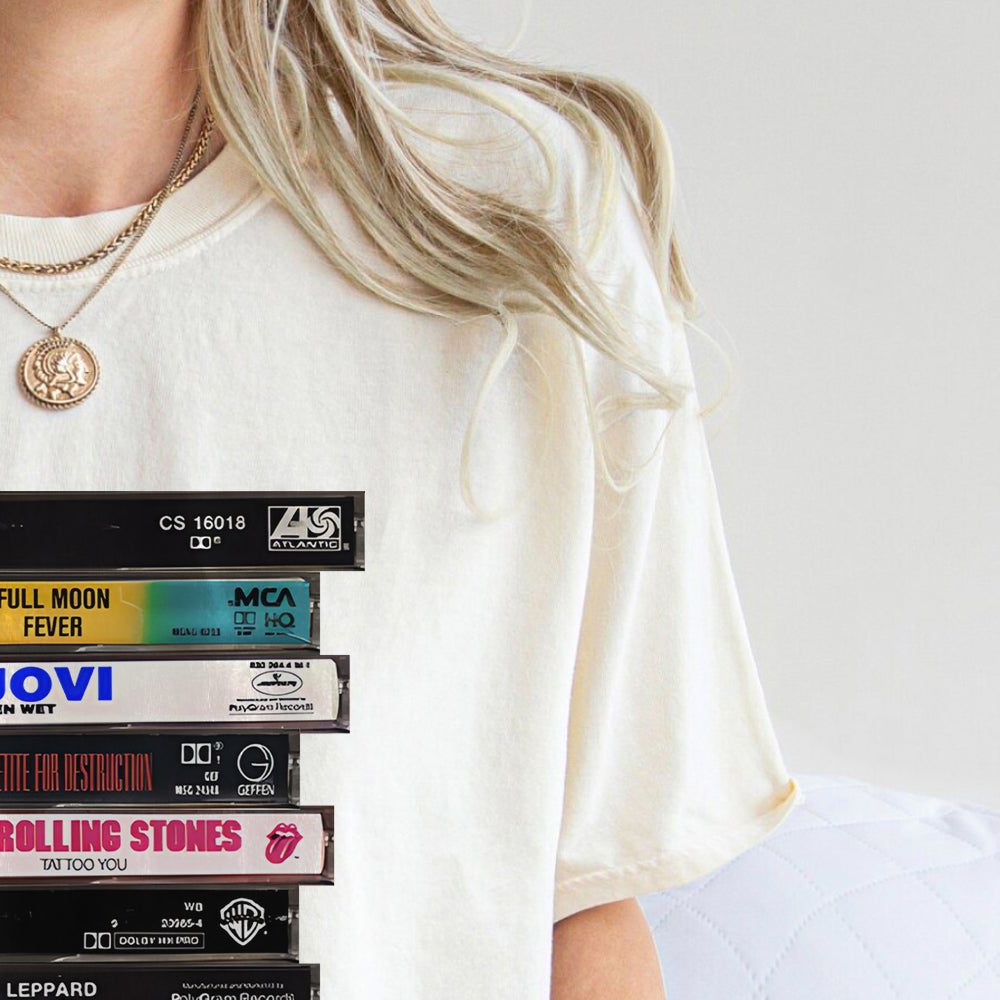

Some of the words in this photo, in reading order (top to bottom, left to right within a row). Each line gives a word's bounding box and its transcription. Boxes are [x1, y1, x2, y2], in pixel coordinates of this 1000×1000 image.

[159, 515, 186, 531] CS
[193, 515, 246, 530] 16018
[51, 588, 110, 608] MOON
[234, 587, 297, 607] MCA
[24, 616, 82, 637] FEVER
[20, 703, 56, 714] WET
[34, 753, 60, 792] FOR
[64, 753, 153, 792] DESTRUCTION
[130, 820, 242, 852] STONES
[40, 858, 94, 871] TATTOO
[98, 858, 127, 871] YOU
[7, 982, 97, 997] LEPPARD
